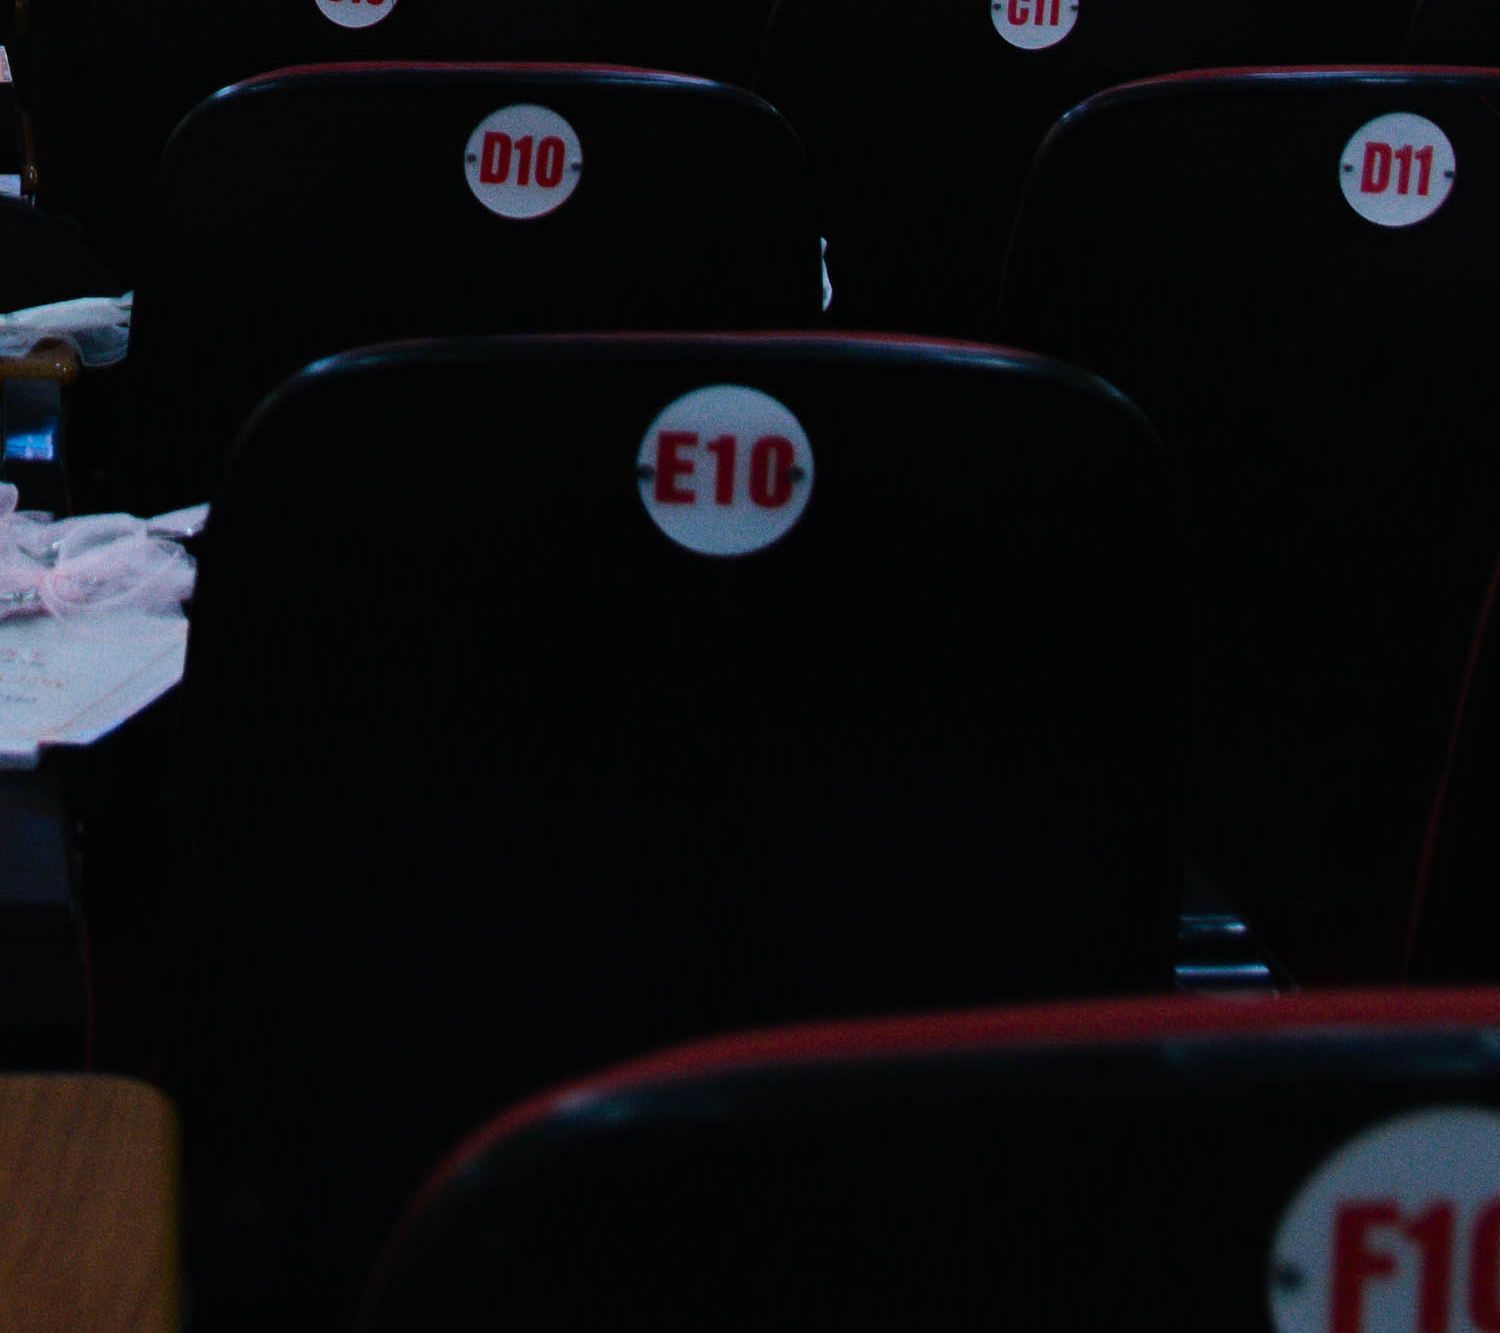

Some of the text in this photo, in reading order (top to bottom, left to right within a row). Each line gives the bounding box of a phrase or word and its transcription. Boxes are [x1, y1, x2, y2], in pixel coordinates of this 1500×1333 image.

[479, 132, 565, 188] D10
[1361, 143, 1432, 195] D11
[655, 431, 794, 509] E10
